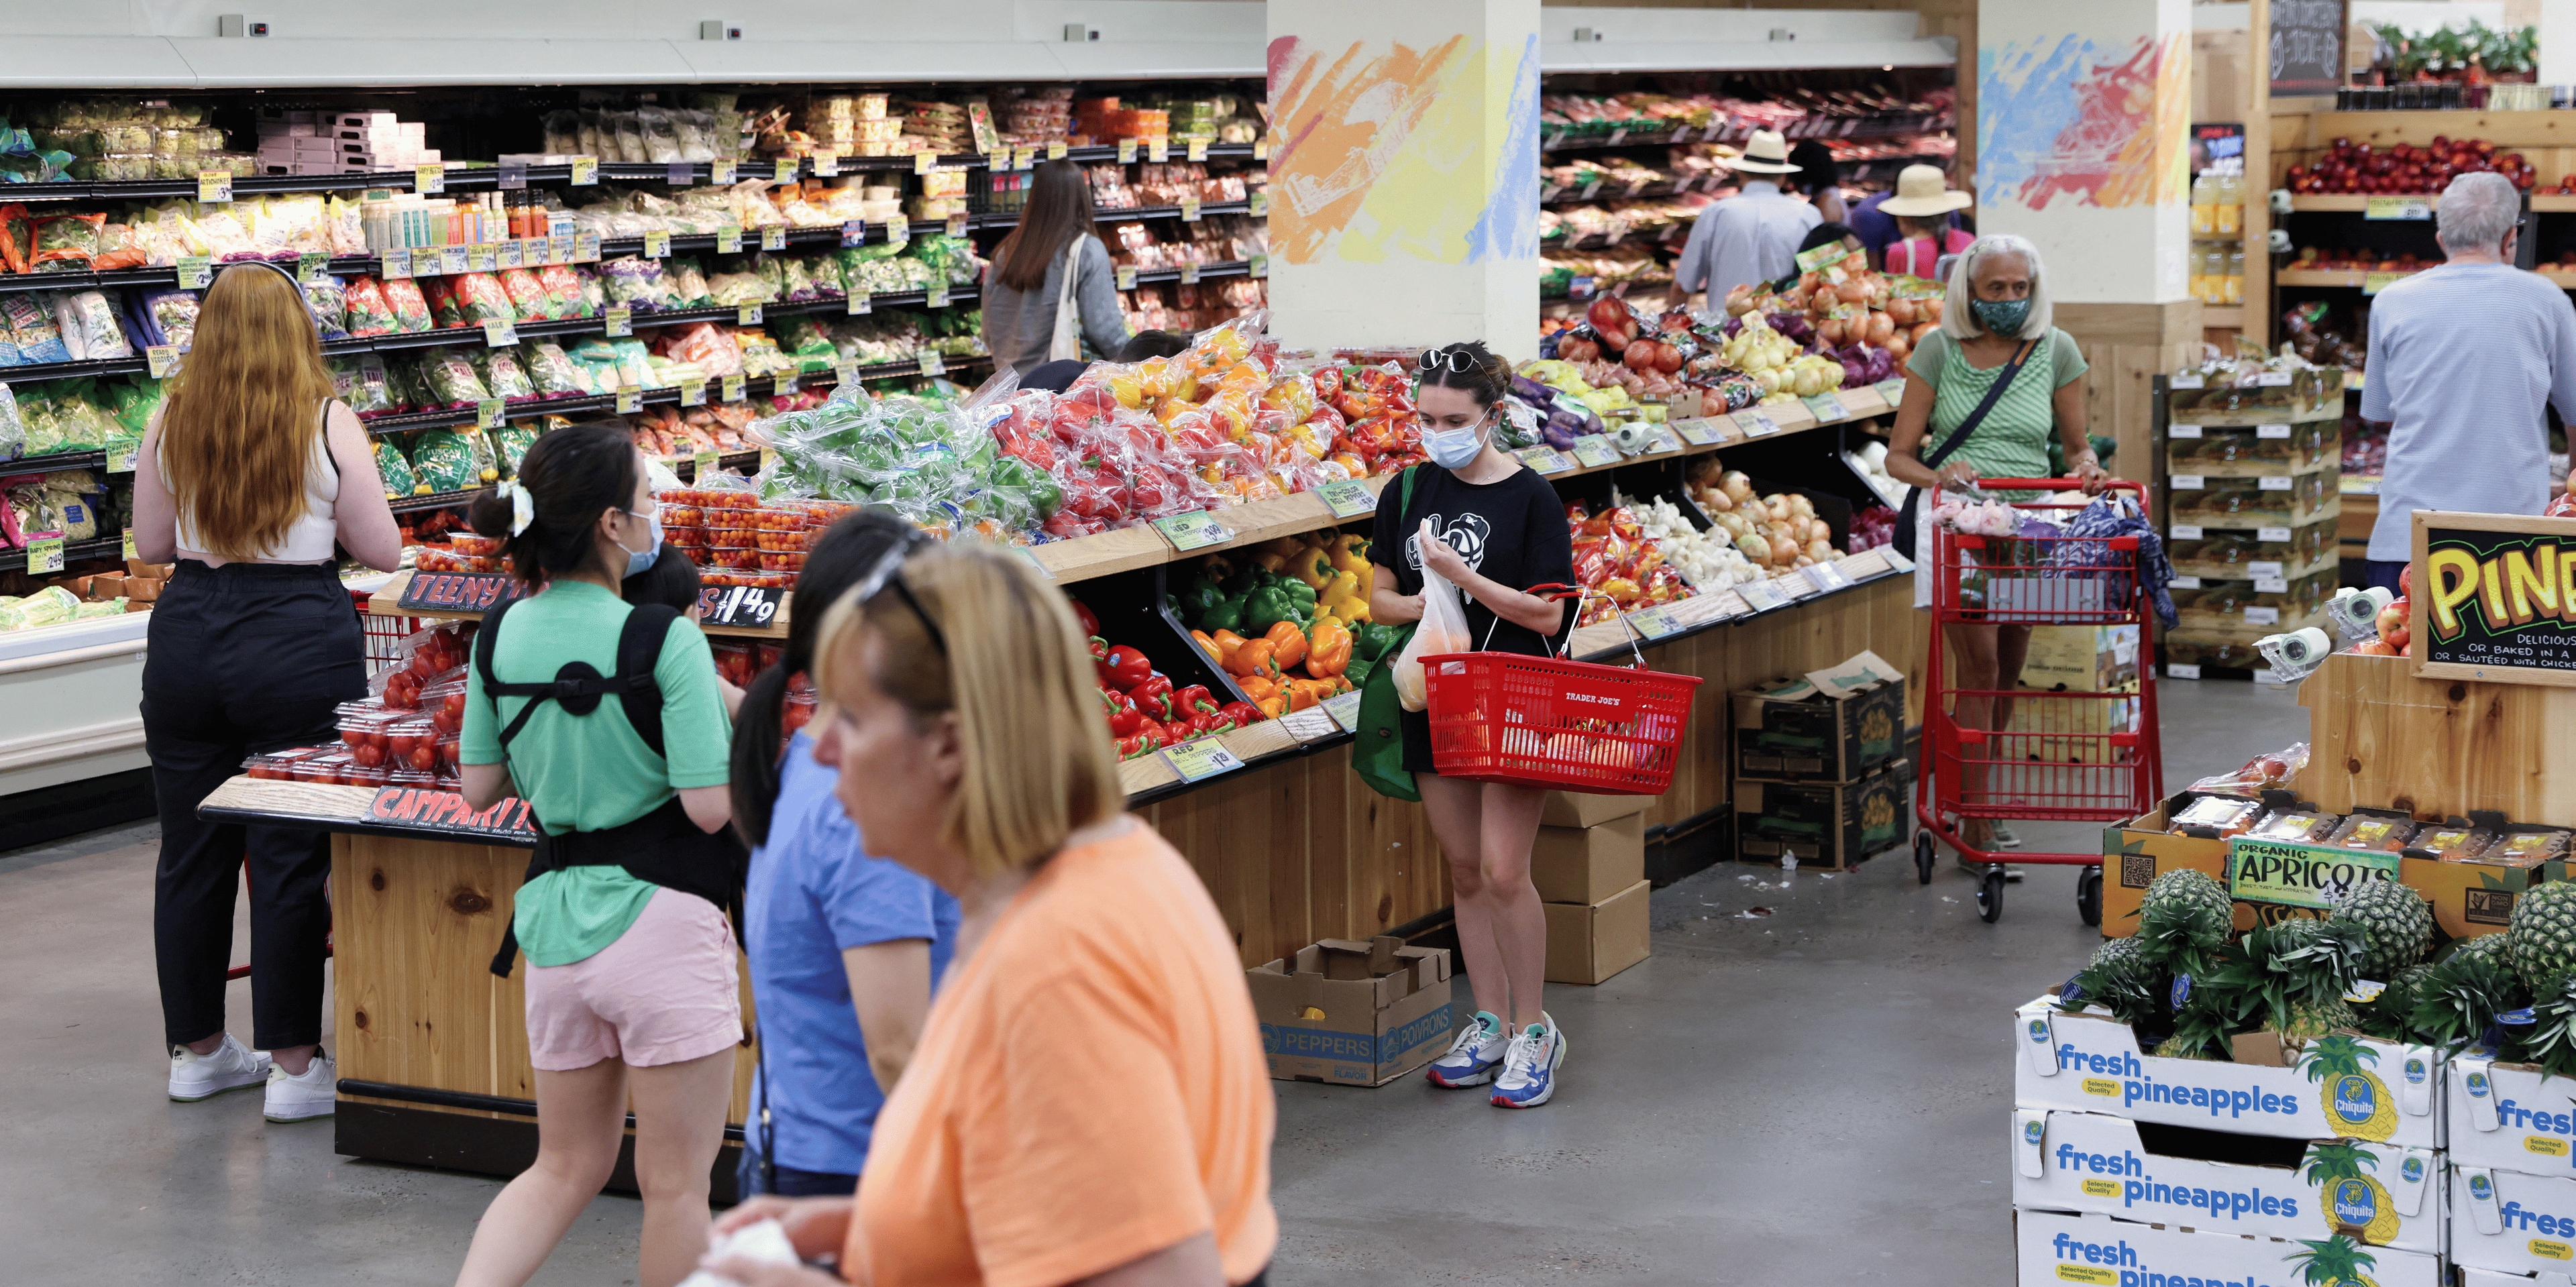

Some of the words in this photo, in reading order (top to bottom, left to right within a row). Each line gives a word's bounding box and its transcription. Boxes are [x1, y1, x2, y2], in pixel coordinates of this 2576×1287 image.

[200, 177, 229, 185] ARTICHOKES
[150, 355, 176, 363] VEGGIES
[107, 443, 134, 453] CHOPPED
[109, 448, 135, 457] ROMAINE
[1326, 486, 1360, 498] TRI-COLOR
[1343, 491, 1366, 502] PEPPERS
[1171, 523, 1190, 533] RED
[1171, 532, 1183, 540] BELL
[1182, 526, 1203, 537] PEPPERS
[29, 547, 43, 555] BABY
[44, 543, 62, 551] SPRING
[409, 574, 506, 606] TEENY
[2517, 634, 2576, 646] DELICIOUS
[2468, 642, 2487, 653] OR
[2493, 645, 2534, 657] BAKED
[2540, 649, 2553, 657] IN
[2561, 651, 2570, 659] A
[2434, 652, 2450, 660] OR
[2459, 654, 2508, 665] SAUTÉED
[1566, 692, 1597, 704] TRADER
[1597, 696, 1621, 706] JOE'S
[1172, 744, 1194, 757] RED
[1172, 757, 1189, 765] BELL
[1188, 747, 1218, 759] PEPPERS
[2238, 844, 2309, 860] ORGANIC
[2238, 854, 2395, 889] APRICOTS
[1401, 1008, 1450, 1048] POIVRONS
[2031, 1032, 2049, 1041] Chiquita
[1285, 1033, 1371, 1057] PEPPERS
[2057, 1044, 2141, 1078] fresh
[1334, 1070, 1368, 1080] FLAVOR
[2087, 1080, 2115, 1089] Selected
[2087, 1087, 2111, 1095] Quality
[2124, 1075, 2299, 1119] pineapples
[2334, 1099, 2375, 1116] Chiquita
[2530, 1139, 2561, 1148] Selected
[2530, 1145, 2557, 1154] Quality
[2055, 1143, 2143, 1178] fresh
[2086, 1180, 2115, 1189] Selected
[2086, 1187, 2111, 1196] Quality
[2125, 1175, 2299, 1221] pineapples
[2334, 1202, 2375, 1220] Chiquita
[2501, 1200, 2576, 1239] fres
[2053, 1232, 2138, 1268] fresh
[2534, 1242, 2566, 1251] Selected
[2534, 1249, 2561, 1258] Quality
[2060, 1266, 2088, 1274] Selected
[2088, 1269, 2112, 1279] Quality
[2060, 1272, 2096, 1282] Pineapples
